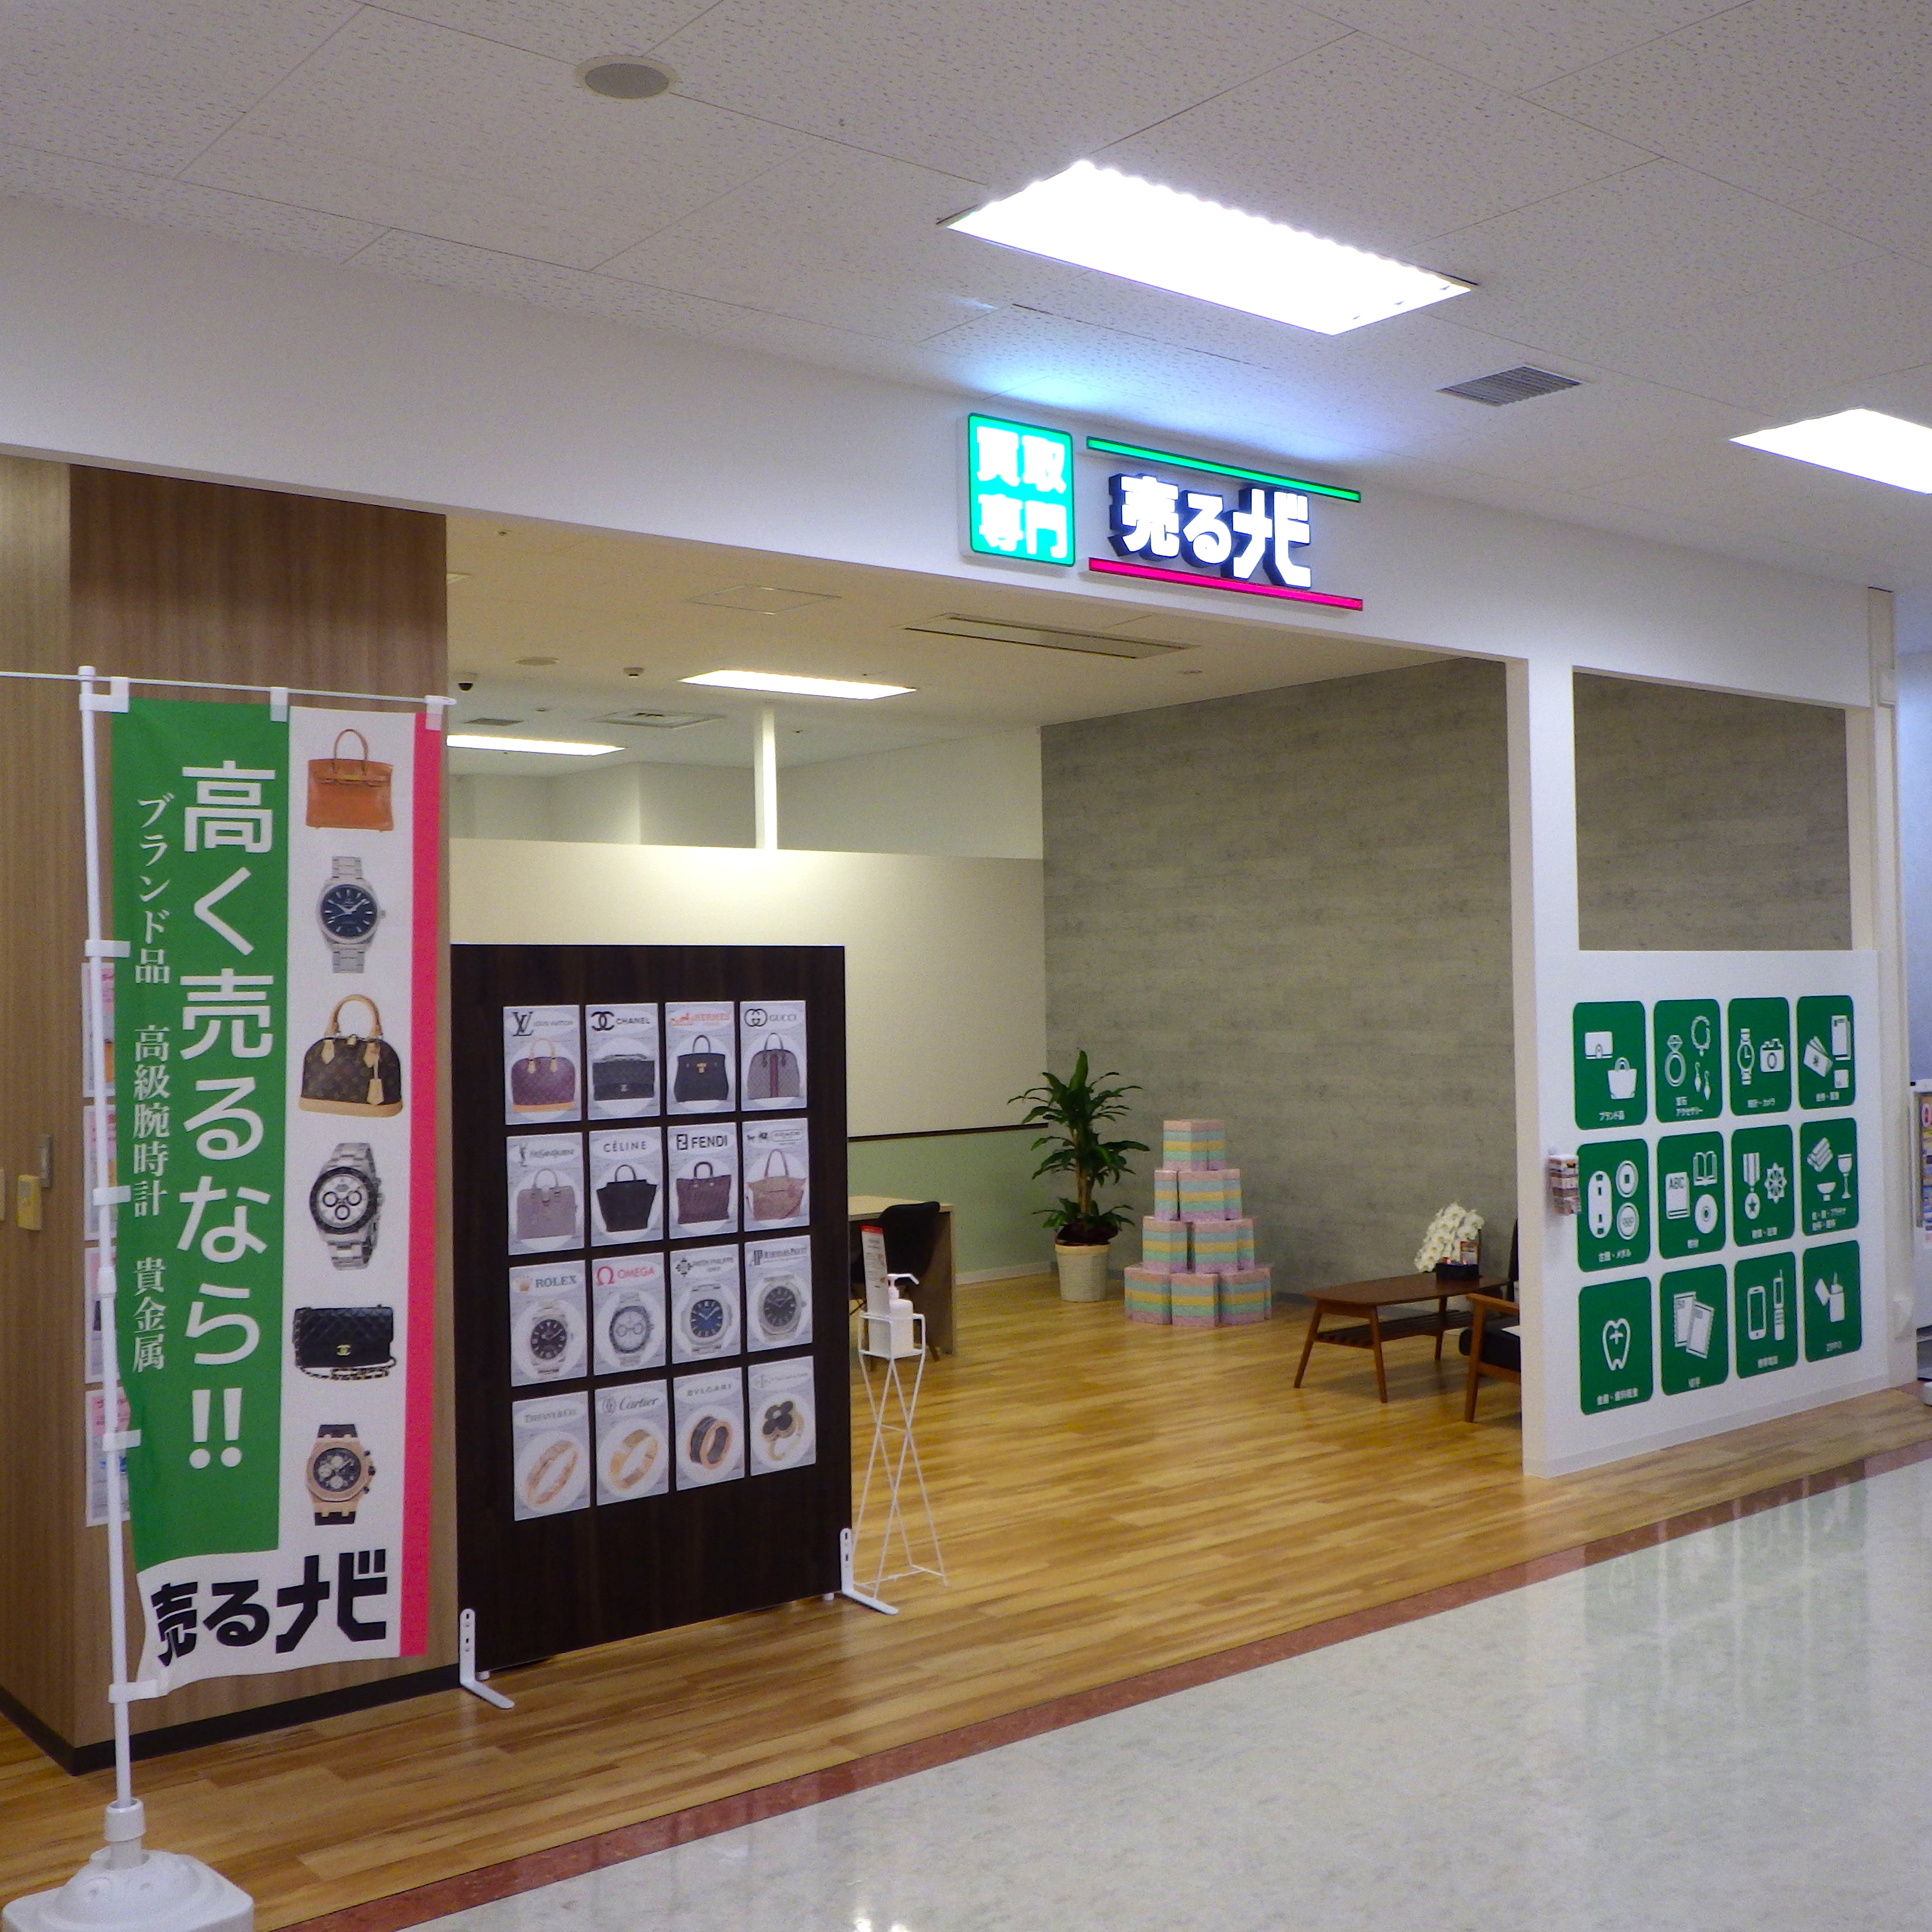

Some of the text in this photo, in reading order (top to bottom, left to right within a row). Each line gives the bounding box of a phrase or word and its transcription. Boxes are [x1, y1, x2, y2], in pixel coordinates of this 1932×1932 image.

[977, 425, 1067, 494] 買取
[978, 494, 1067, 559] 専門
[1118, 475, 1311, 589] 売るナビ
[132, 792, 175, 1374] ブランド品 高級腕時計 貴金属
[603, 1140, 646, 1153] CÉLINE
[691, 1134, 728, 1149] FENDI
[535, 1275, 576, 1289] ROLEX
[617, 1267, 655, 1279] OMEGA
[618, 1396, 659, 1411] Cartier
[151, 1549, 388, 1667] 売るナビ
